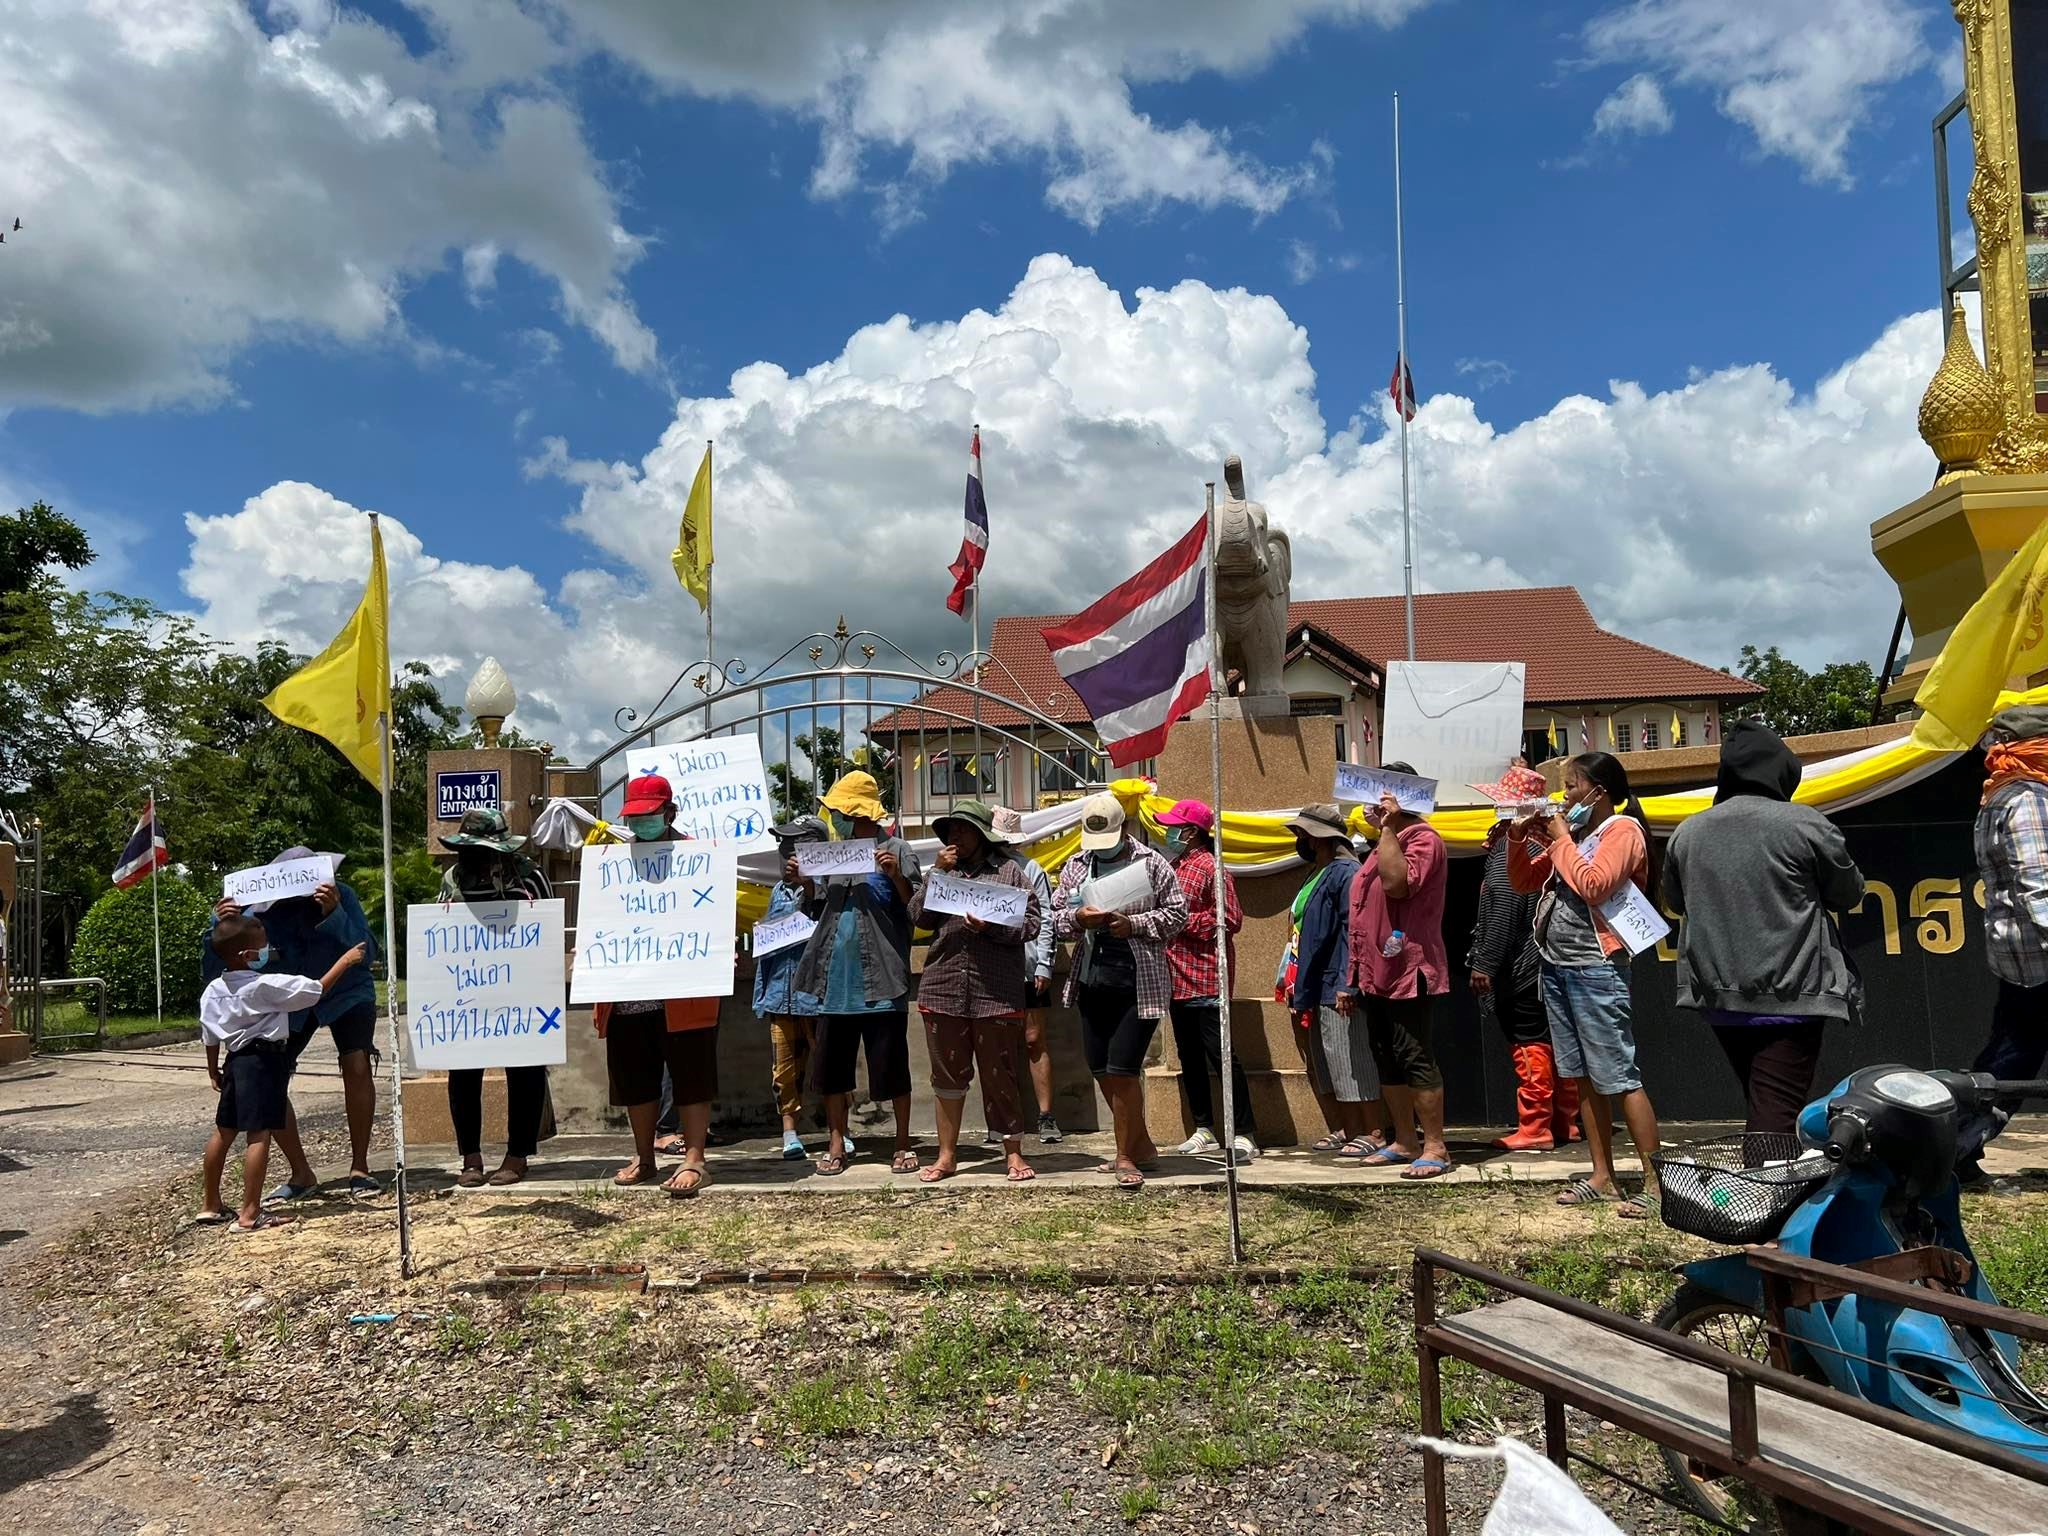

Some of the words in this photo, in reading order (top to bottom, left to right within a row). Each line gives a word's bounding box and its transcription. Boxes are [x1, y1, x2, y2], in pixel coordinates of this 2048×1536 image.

[669, 749, 727, 777] ไม่เอา
[440, 774, 496, 800] ทางเข้า
[673, 783, 737, 812] หันลม
[441, 800, 497, 813] ENTRANCE
[620, 889, 677, 914] ไม่เอา
[755, 918, 817, 947] ไม่เอากังหันล
[585, 926, 711, 969] กังหันลม
[446, 959, 511, 992] ไม่เอา
[415, 998, 532, 1049] กังหันลม
